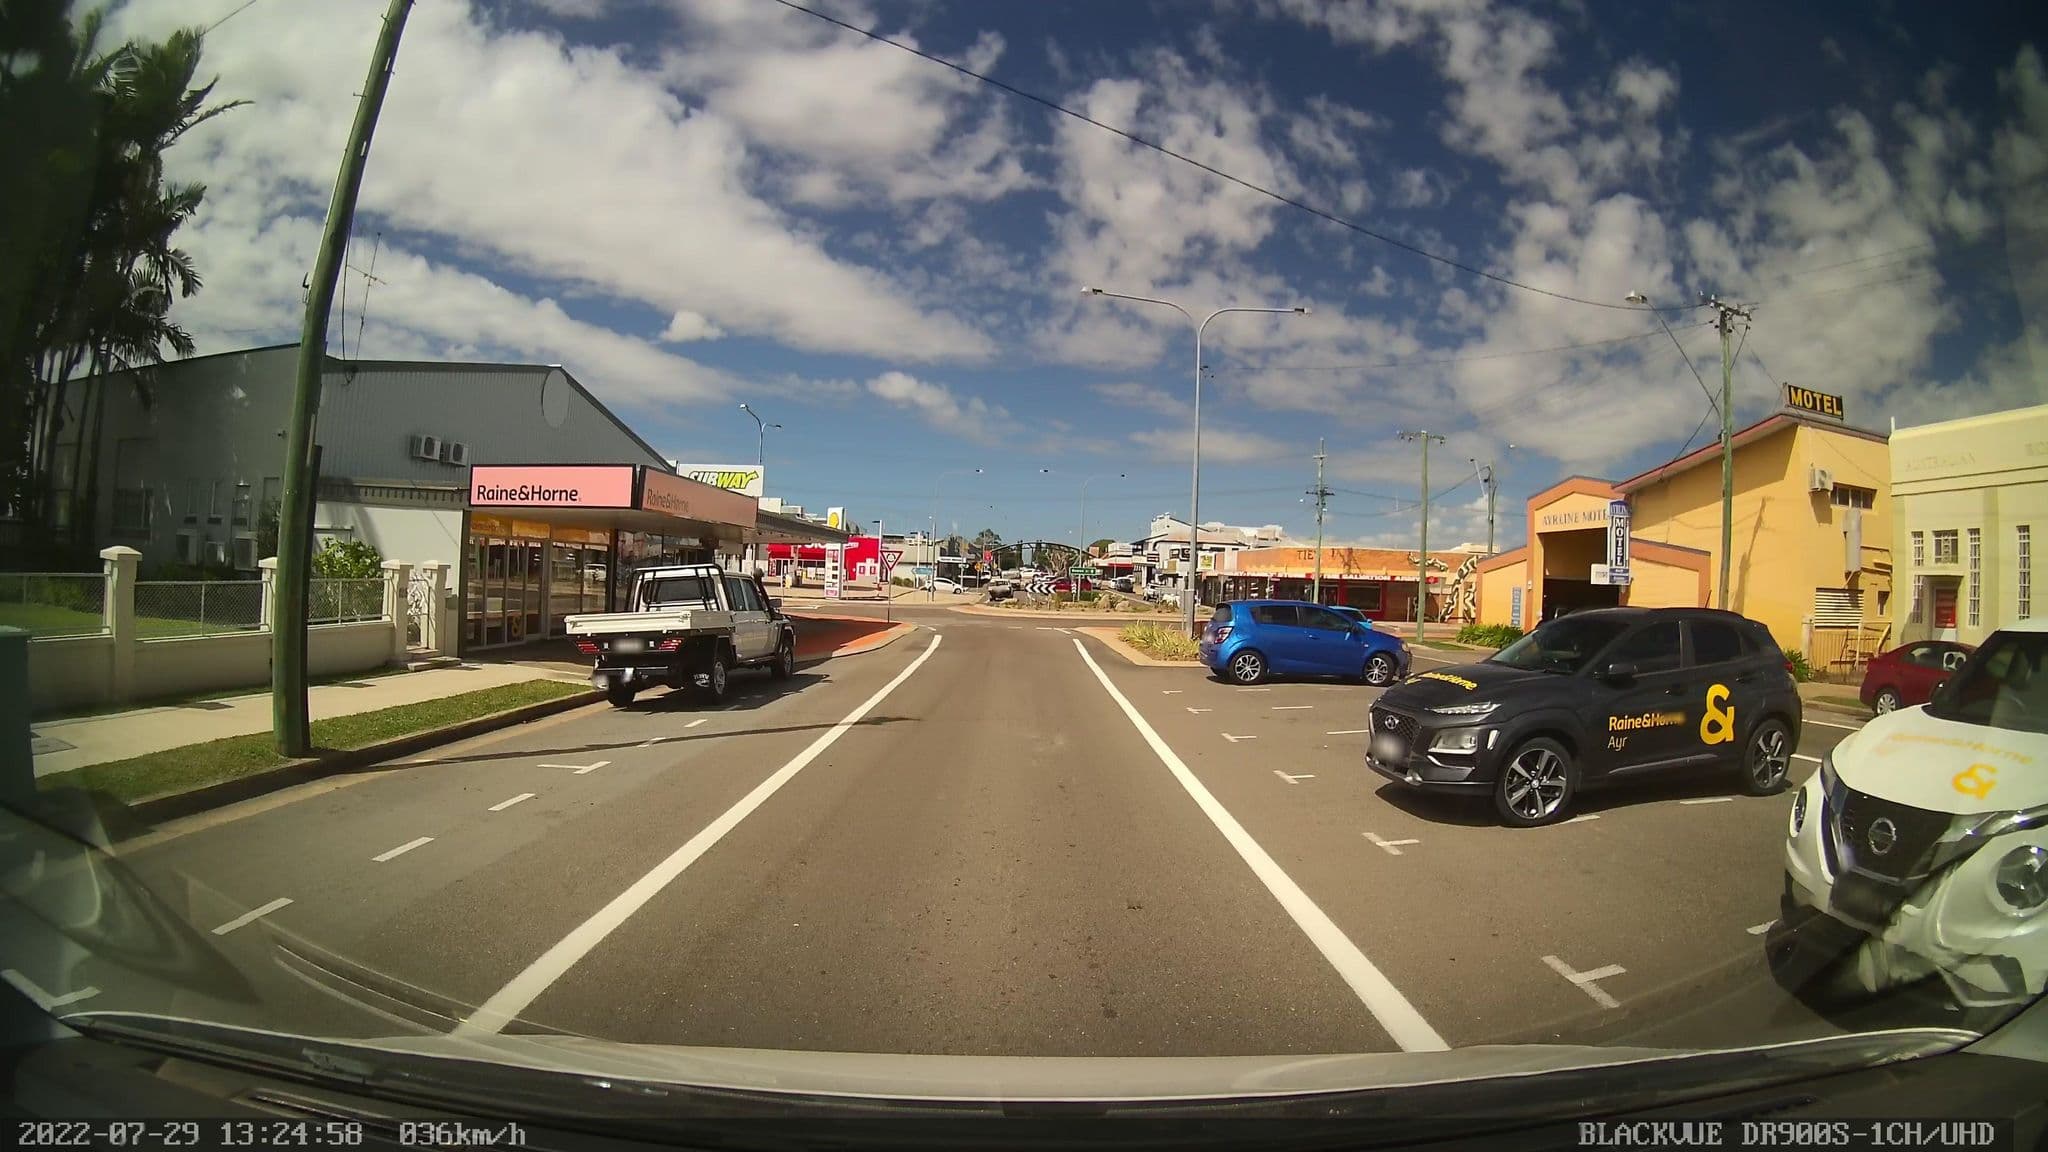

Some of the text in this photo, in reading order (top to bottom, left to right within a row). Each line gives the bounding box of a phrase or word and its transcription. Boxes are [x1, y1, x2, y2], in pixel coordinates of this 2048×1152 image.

[1790, 387, 1842, 415] MOTEL
[477, 484, 579, 501] Raine&Horne
[646, 488, 690, 513] Raine&Horne
[1582, 509, 1609, 522] MOTE
[1615, 518, 1625, 566] MOTEL
[1607, 736, 1628, 751] Ayr
